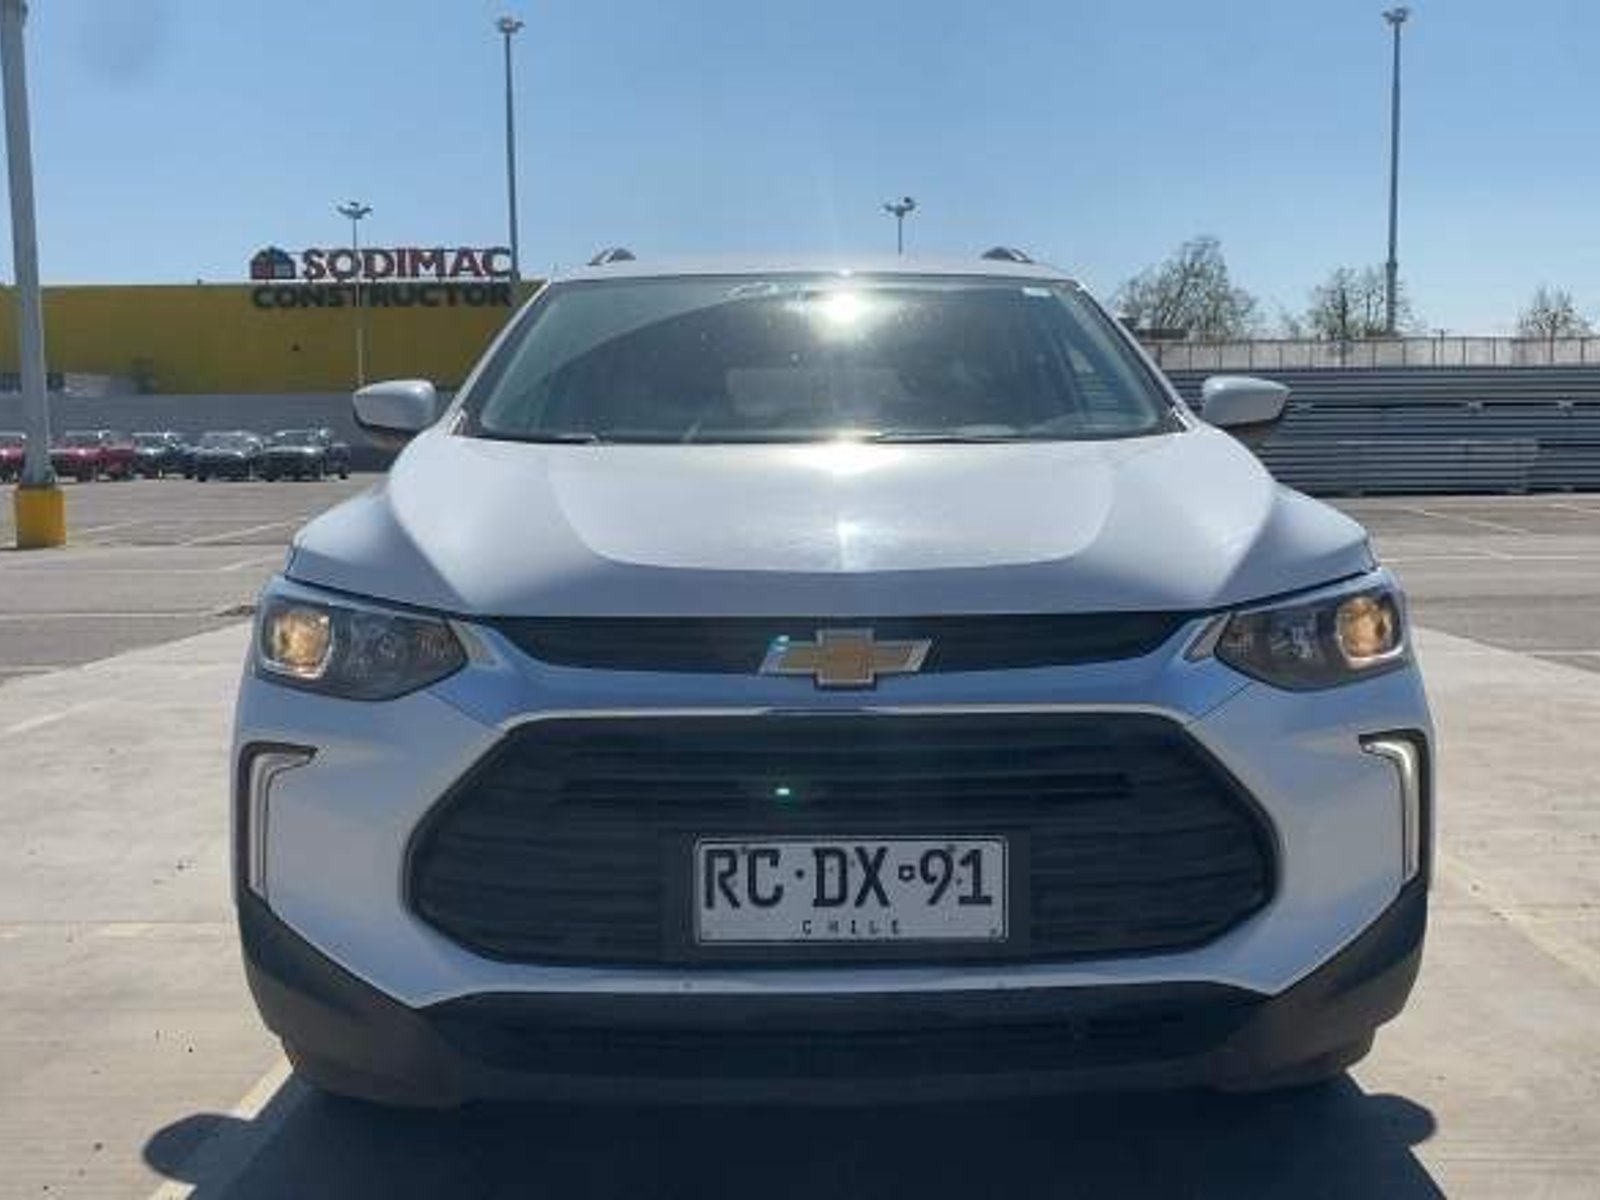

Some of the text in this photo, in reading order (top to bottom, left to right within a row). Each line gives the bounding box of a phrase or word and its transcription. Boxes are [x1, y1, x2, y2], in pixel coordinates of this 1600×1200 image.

[303, 248, 511, 278] SODIMAC
[253, 283, 513, 307] CONSTRUCTOR
[802, 919, 901, 934] CHILE
